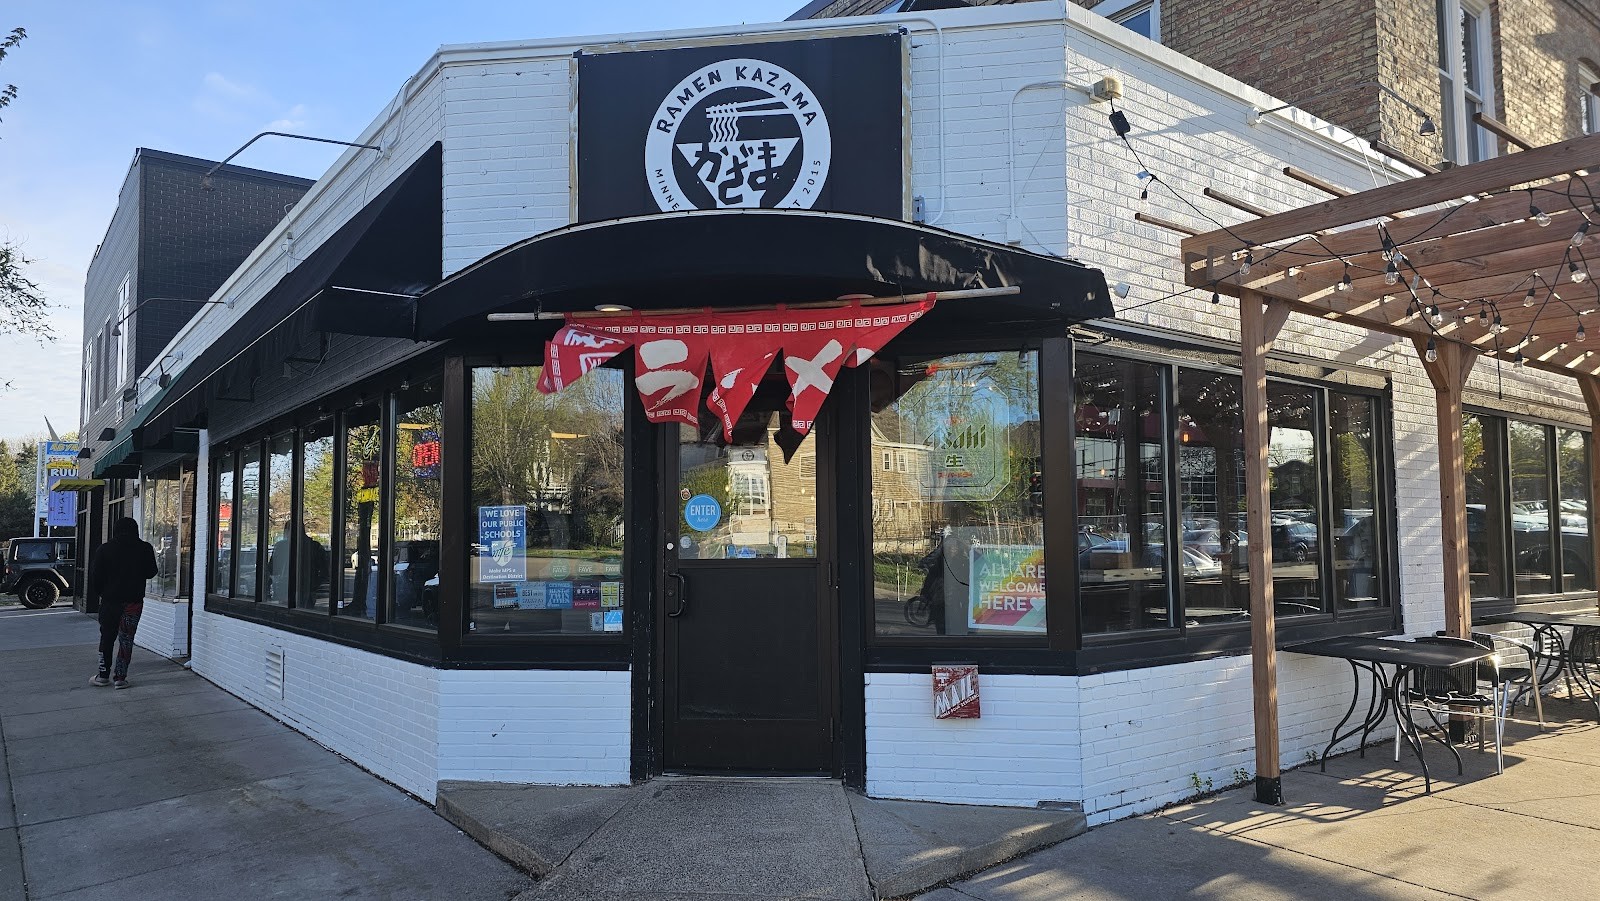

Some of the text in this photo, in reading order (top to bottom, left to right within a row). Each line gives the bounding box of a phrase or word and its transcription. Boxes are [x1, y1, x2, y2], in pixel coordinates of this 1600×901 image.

[656, 66, 817, 134] RAMEN KAZAMA
[802, 160, 821, 194] 2015
[655, 168, 680, 211] MINNE
[923, 424, 986, 449] Asahi
[412, 441, 441, 467] OPEN
[946, 454, 963, 467] 生
[485, 509, 520, 518] WE LOVE
[690, 505, 716, 516] ENTER
[482, 519, 524, 528] OUR PUBLIC
[484, 530, 521, 538] SCHOOLS
[979, 562, 1046, 579] ALL ARE
[979, 580, 1046, 593] WELCOME
[979, 592, 1027, 612] HERE
